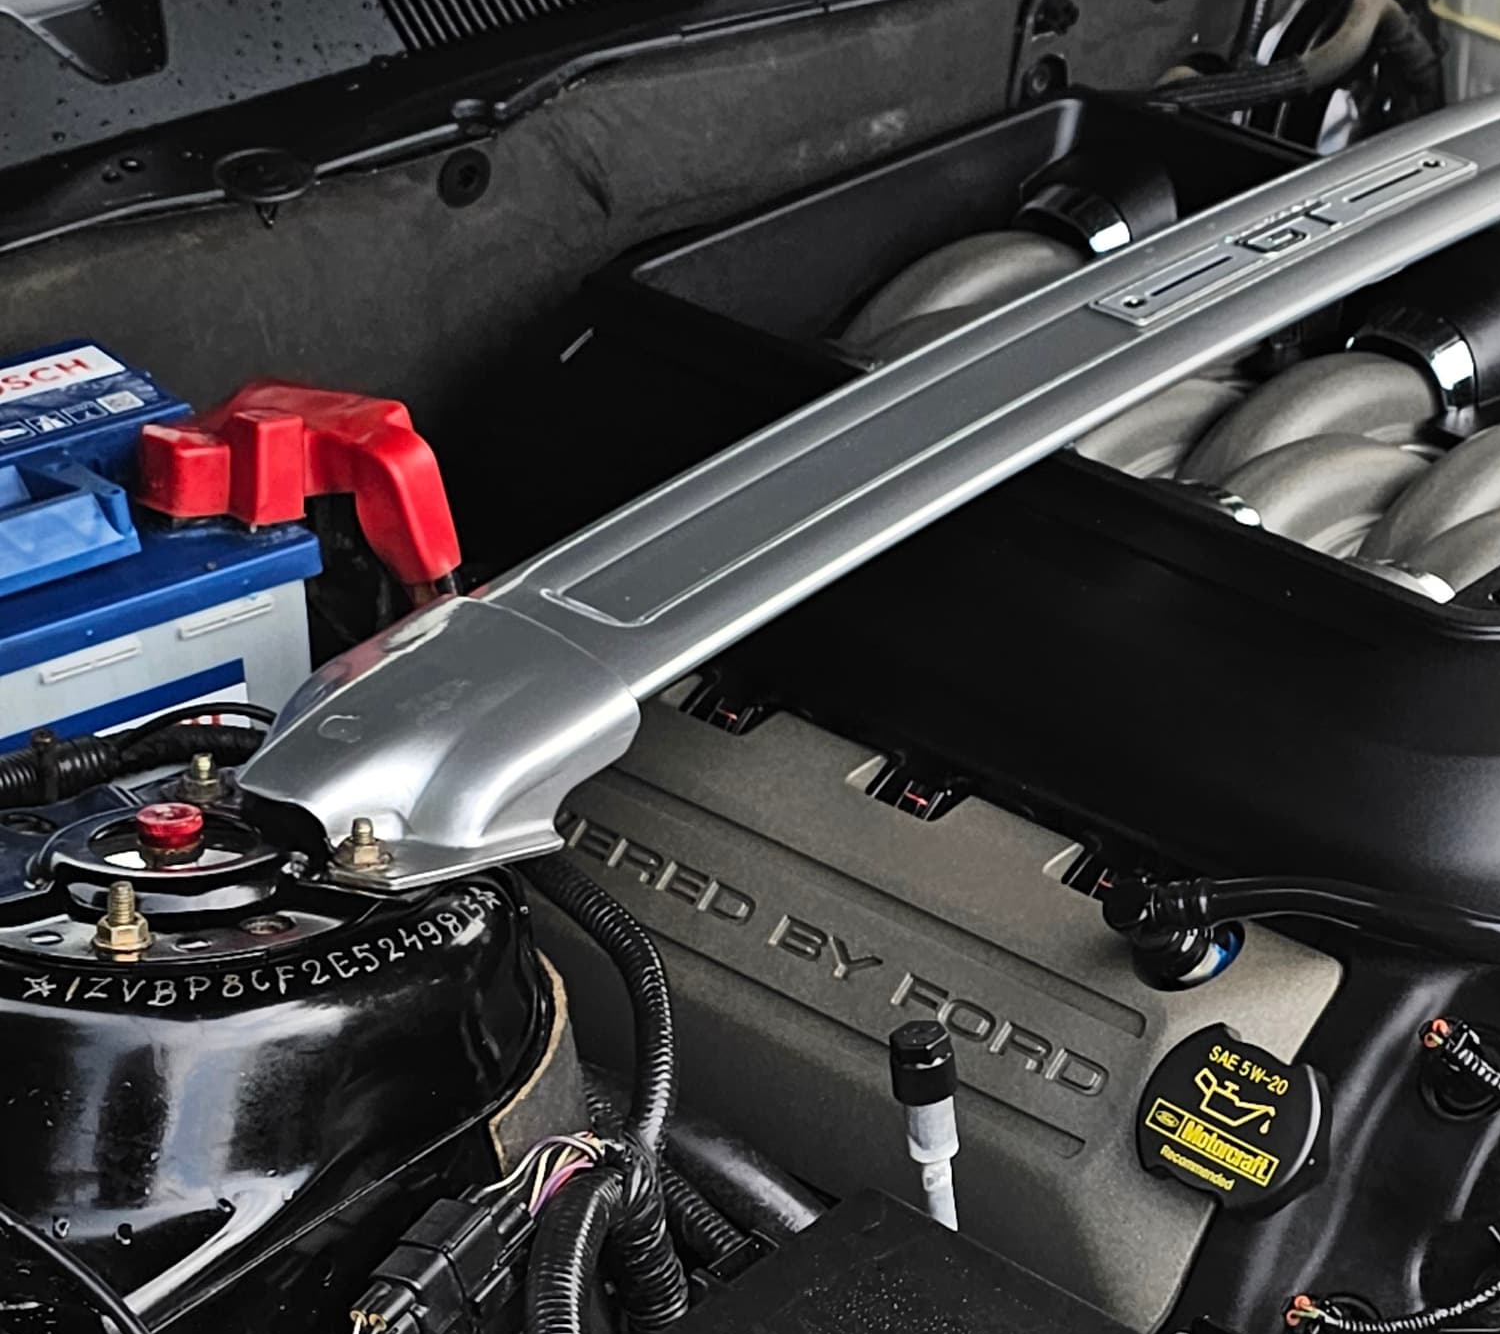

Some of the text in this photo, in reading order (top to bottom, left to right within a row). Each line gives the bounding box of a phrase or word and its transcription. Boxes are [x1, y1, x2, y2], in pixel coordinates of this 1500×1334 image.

[0, 358, 91, 395] SCH
[556, 811, 1110, 1098] ERED BY FORD
[1209, 1045, 1289, 1097] SAE 5W-20
[1181, 1119, 1270, 1180] Motorcraft
